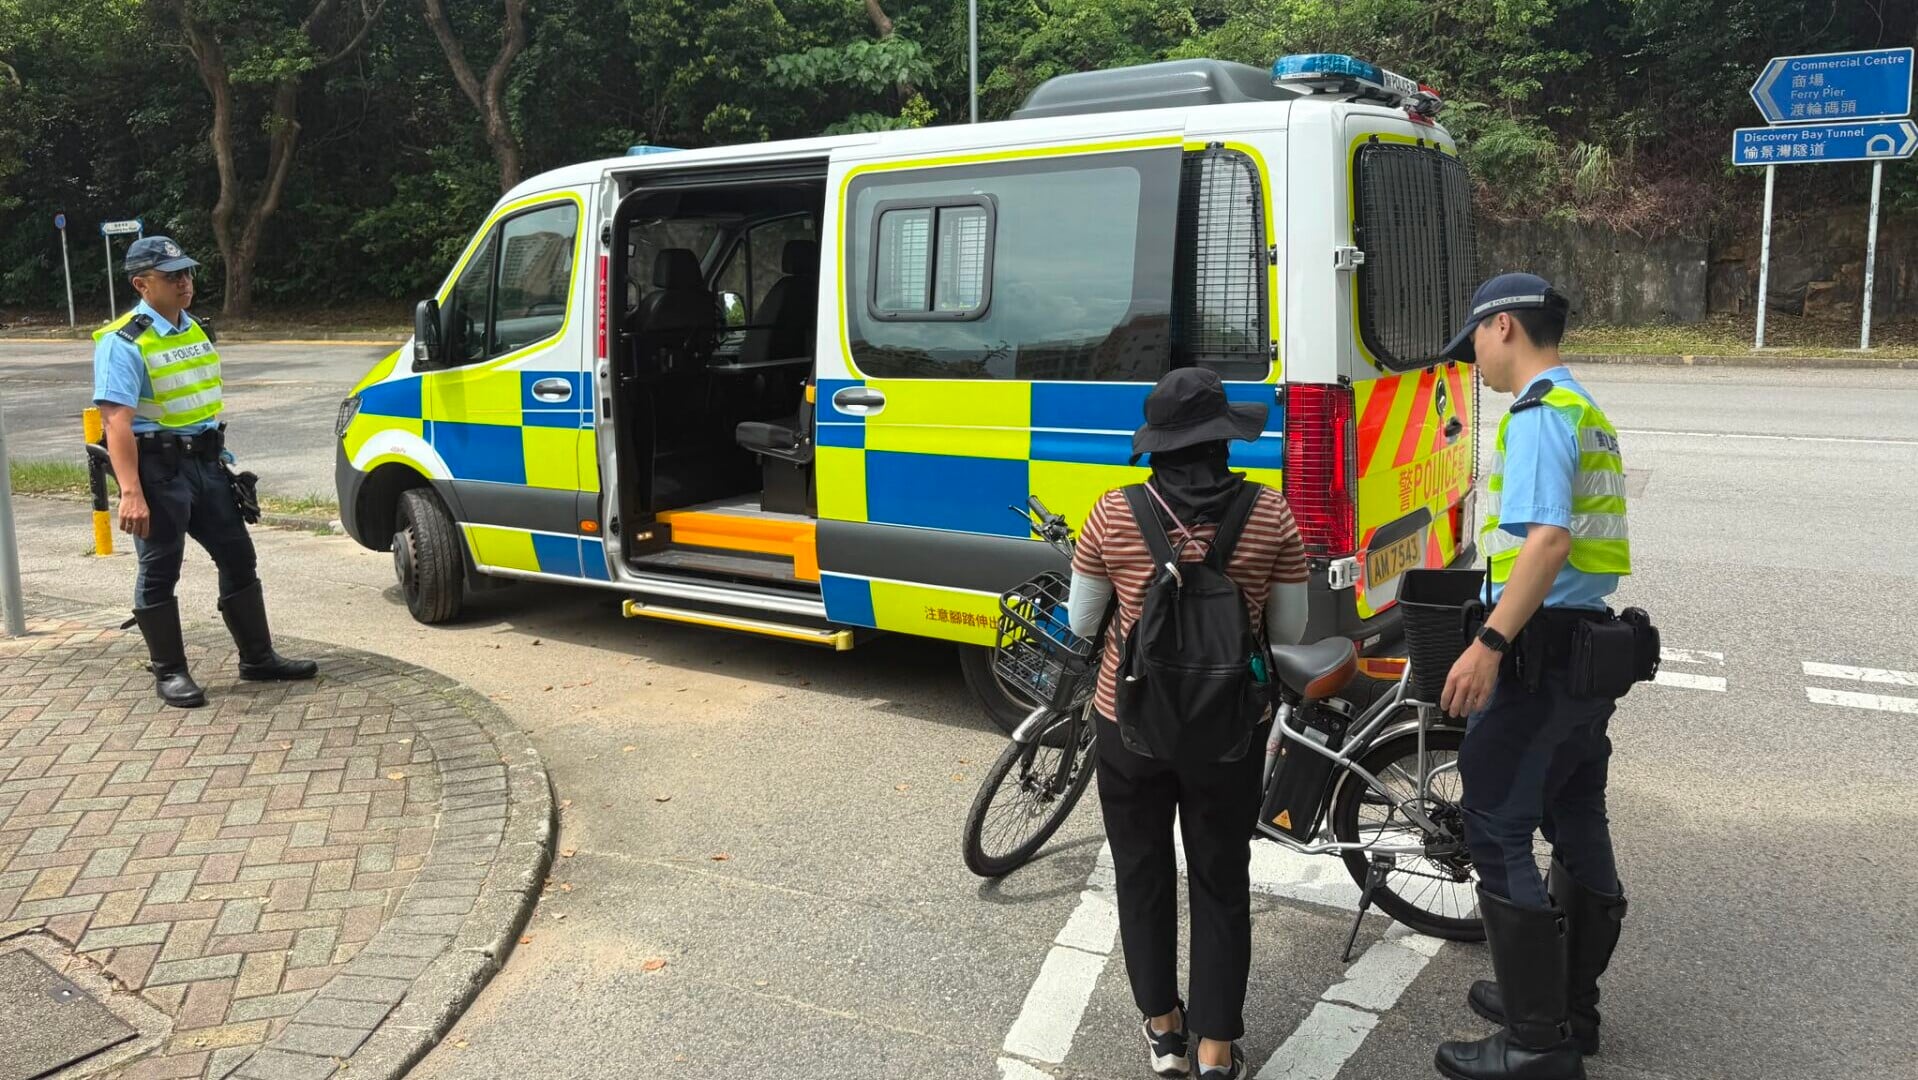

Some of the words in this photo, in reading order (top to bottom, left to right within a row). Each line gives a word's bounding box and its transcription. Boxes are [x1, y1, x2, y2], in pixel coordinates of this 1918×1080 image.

[1791, 57, 1861, 71] Commercial
[1864, 55, 1905, 67] Centre
[1791, 73, 1824, 88] 商場
[1791, 90, 1820, 100] Ferry
[1822, 87, 1846, 98] Pier
[1790, 100, 1857, 117] 渡輪碼頭
[1744, 132, 1798, 143] Discovery
[1801, 130, 1823, 140] Bay
[1826, 127, 1865, 139] Tunnel
[1743, 143, 1825, 160] 愉景灣隧道
[172, 344, 201, 361] POLICE
[1413, 446, 1457, 507] POLICE
